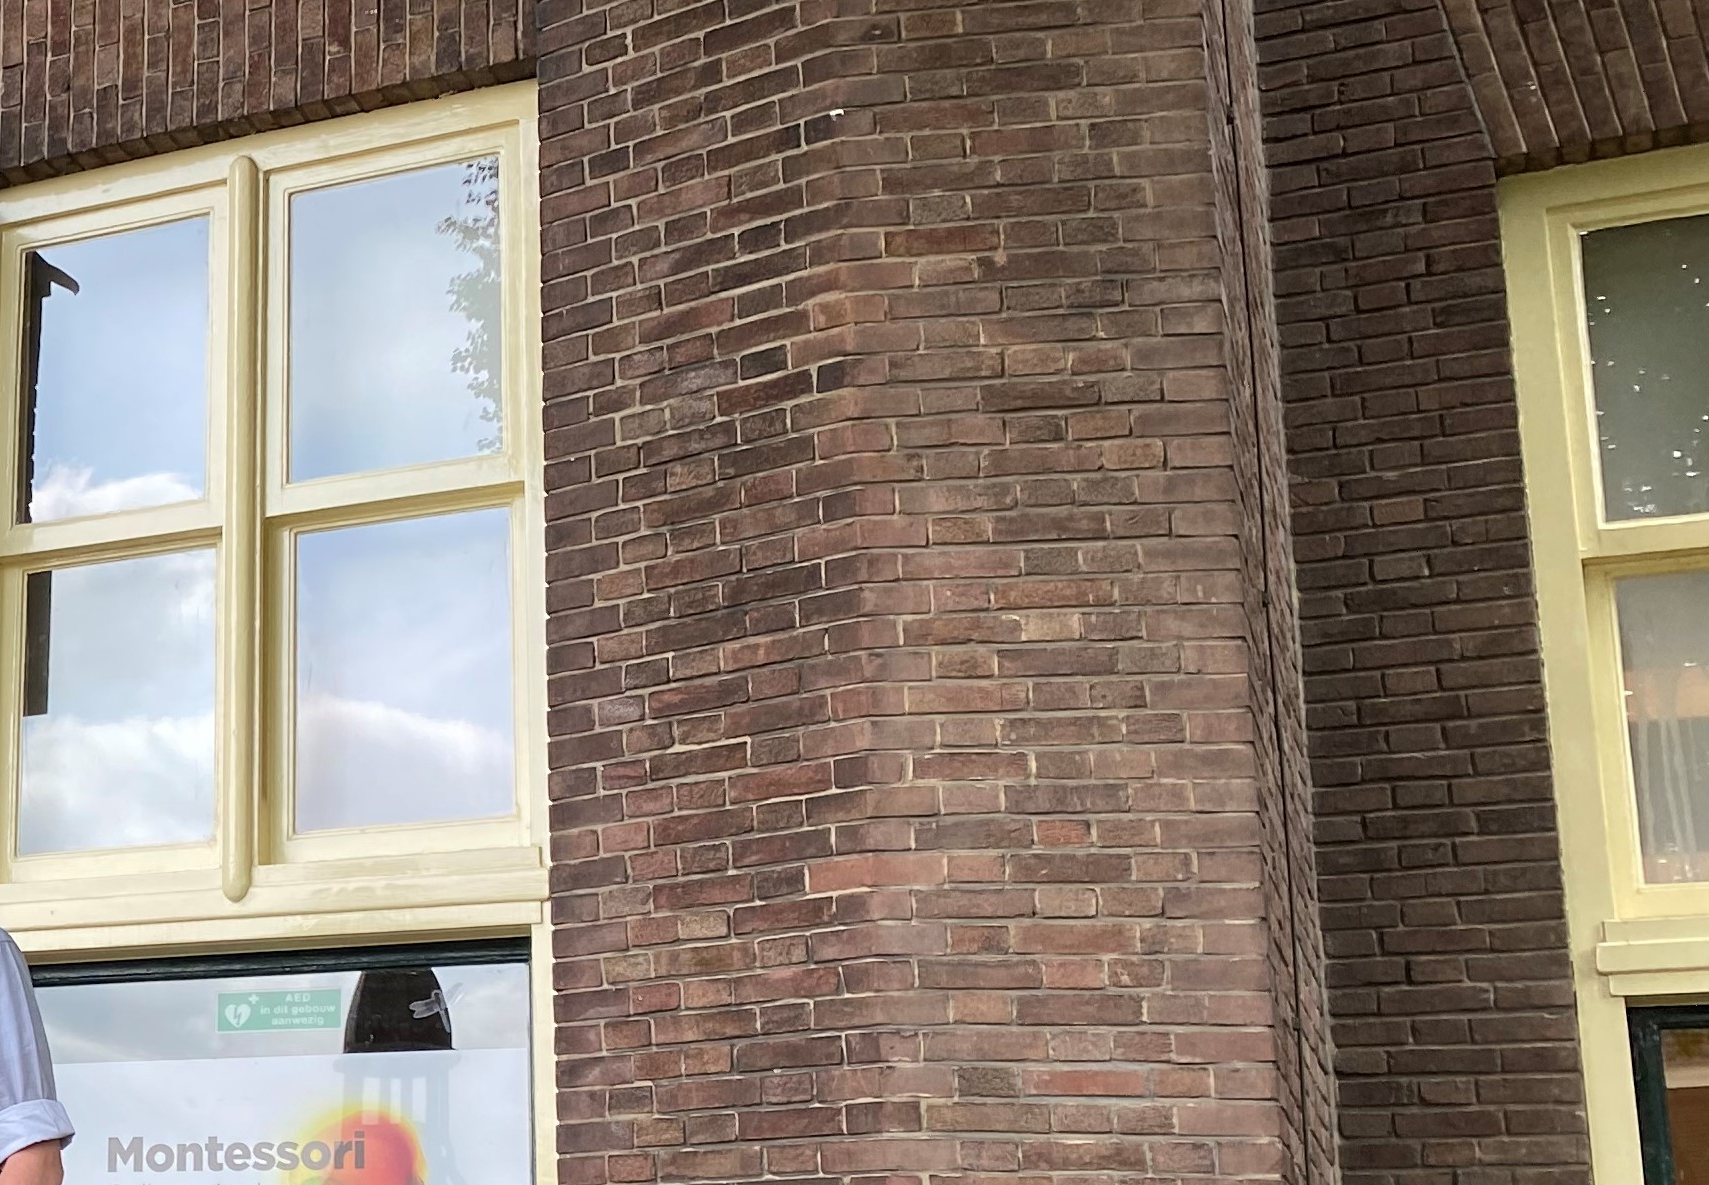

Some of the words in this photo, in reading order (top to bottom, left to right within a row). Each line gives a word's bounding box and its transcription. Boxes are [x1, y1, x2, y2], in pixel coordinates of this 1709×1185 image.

[285, 993, 311, 1003] AED
[260, 1005, 271, 1015] in
[273, 1005, 289, 1015] dit
[291, 1004, 336, 1016] gebouw
[271, 1015, 324, 1026] aanwezig
[107, 1130, 365, 1172] Montessori
